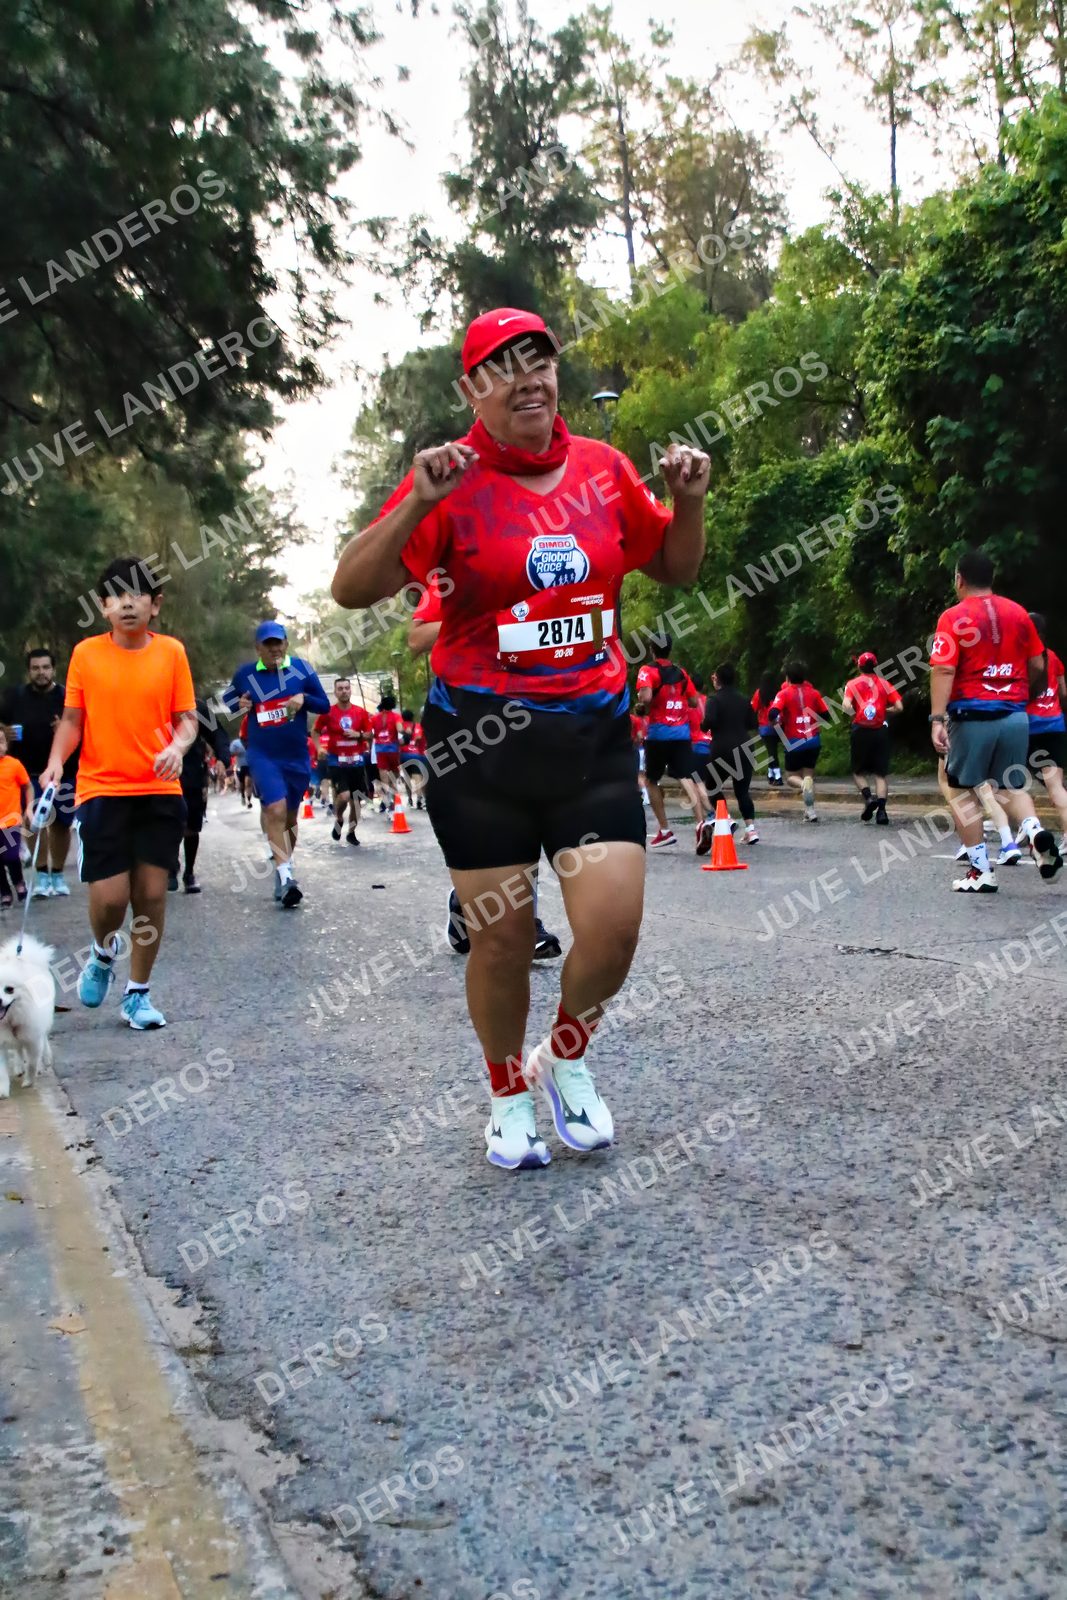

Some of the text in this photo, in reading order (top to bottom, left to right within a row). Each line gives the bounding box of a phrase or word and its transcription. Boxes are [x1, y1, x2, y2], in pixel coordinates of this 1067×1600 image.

[538, 540, 571, 549] BIMBO
[541, 551, 573, 563] Global
[536, 561, 562, 573] Race
[538, 617, 585, 646] 2874
[982, 663, 1013, 677] 20-26
[267, 708, 285, 721] 1593
